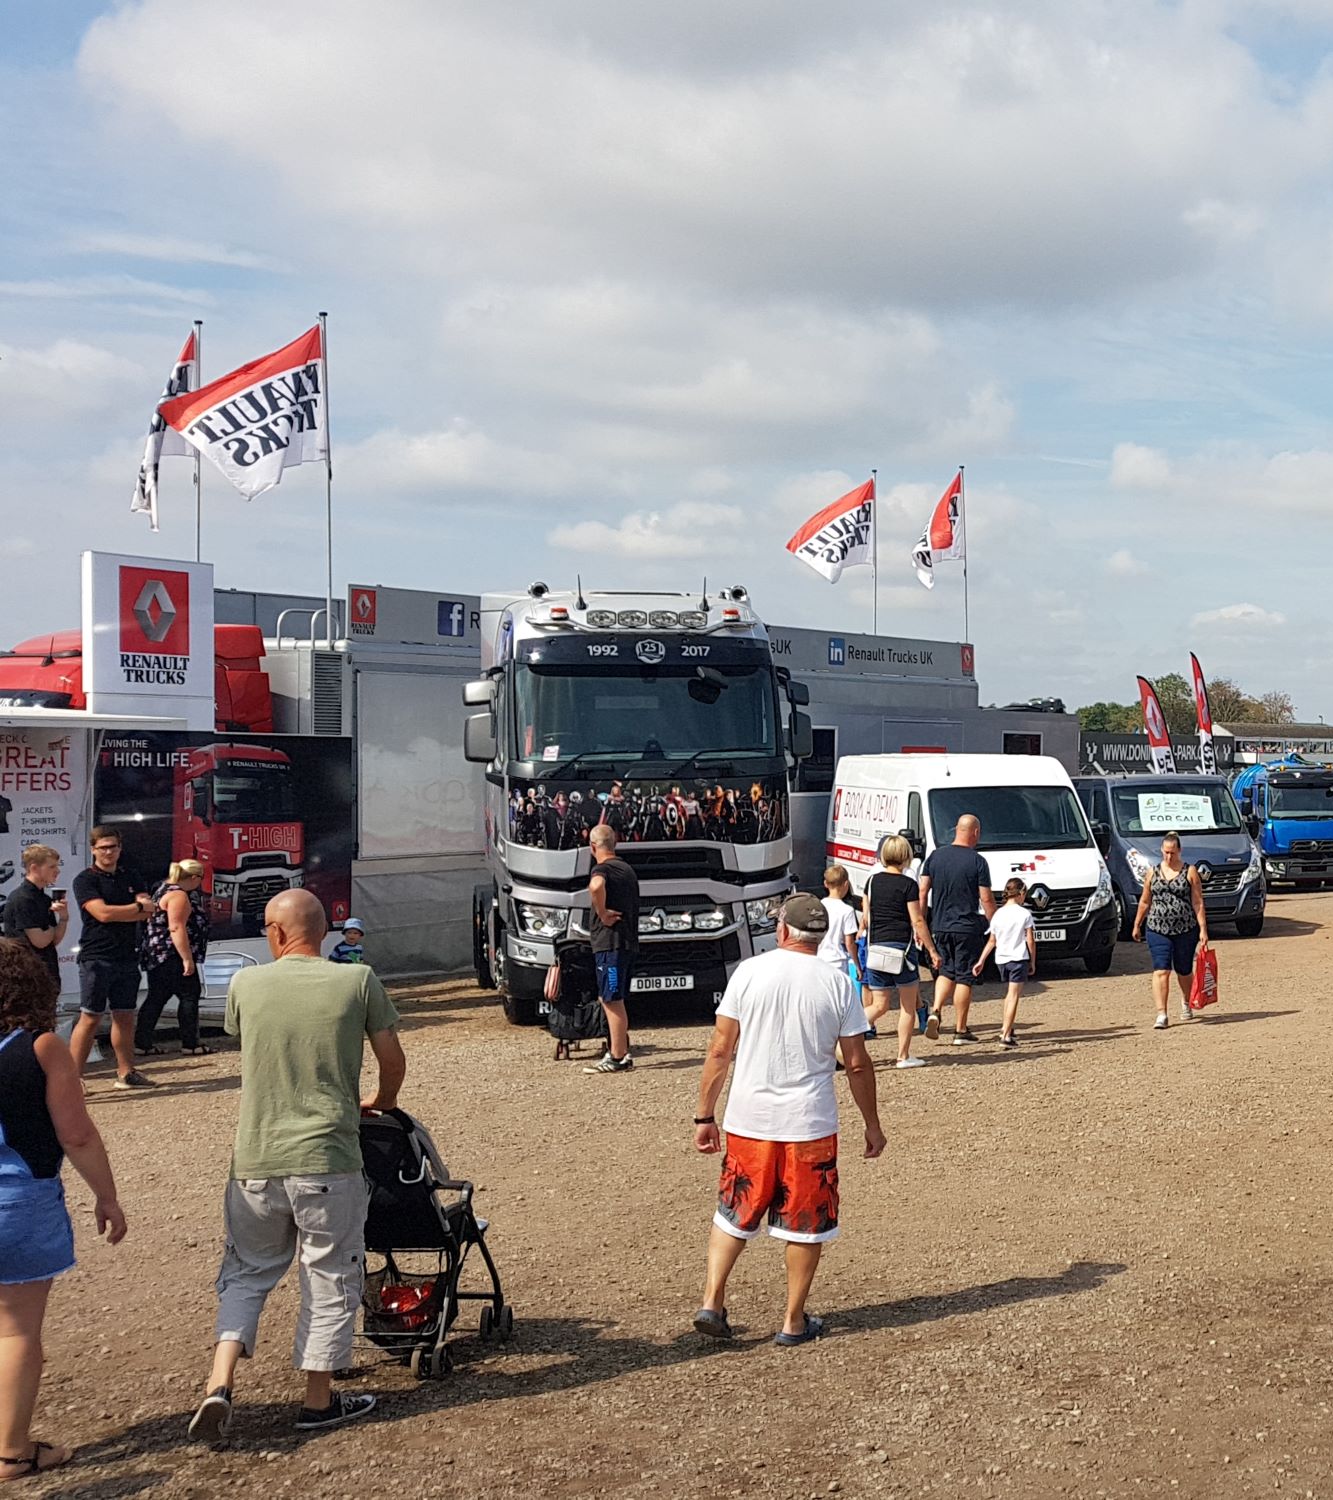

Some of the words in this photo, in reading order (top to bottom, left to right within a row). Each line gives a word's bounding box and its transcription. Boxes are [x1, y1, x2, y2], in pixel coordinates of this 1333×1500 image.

[587, 645, 619, 656] 1992
[644, 643, 656, 652] 25
[681, 645, 710, 657] 2017
[830, 641, 843, 662] in
[848, 645, 885, 662] Renault
[887, 649, 918, 664] Trucks
[919, 651, 933, 665] UK
[120, 654, 189, 671] RENAULT
[123, 669, 186, 685] TRUCKS
[100, 739, 128, 748] LIVING
[130, 739, 148, 748] THE
[0, 747, 70, 769] REAT
[114, 752, 151, 767] HIGH
[157, 752, 193, 768] LIFE.
[20, 806, 53, 814] JACKETS
[844, 791, 866, 819] BOOK
[866, 794, 872, 821] A
[873, 794, 898, 823] DEMO
[21, 828, 40, 836] POLO
[41, 827, 67, 835] SHIRTS
[229, 826, 297, 850] T-HIGH
[1044, 930, 1061, 940] UCU
[636, 977, 661, 990] DD18
[665, 976, 687, 988] DXD
